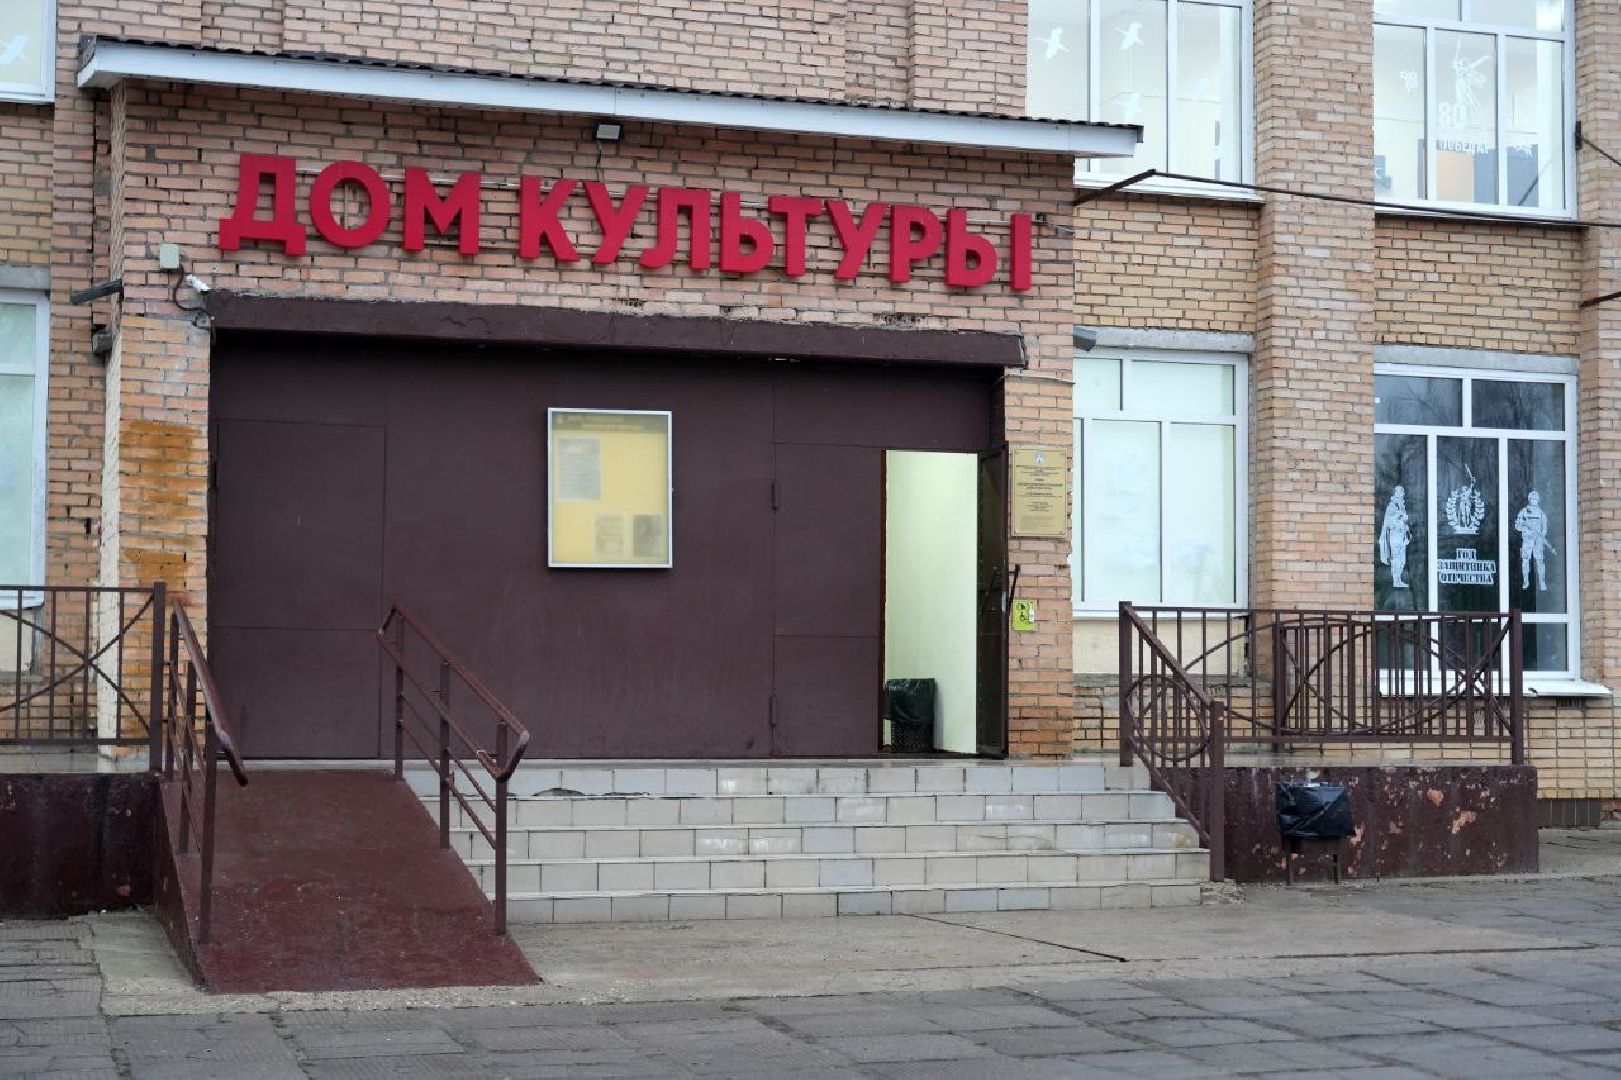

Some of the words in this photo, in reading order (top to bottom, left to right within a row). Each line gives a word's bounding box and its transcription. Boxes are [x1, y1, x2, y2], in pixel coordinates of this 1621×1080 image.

[1438, 102, 1467, 128] 80
[218, 154, 481, 257] ДОМ
[518, 176, 1032, 291] КУЛЬТУРЫ
[1457, 549, 1476, 559] ГОД
[1437, 560, 1495, 572] ЗАЩИТНИКА
[1440, 572, 1494, 583] ОТЕЧЕСТВА
